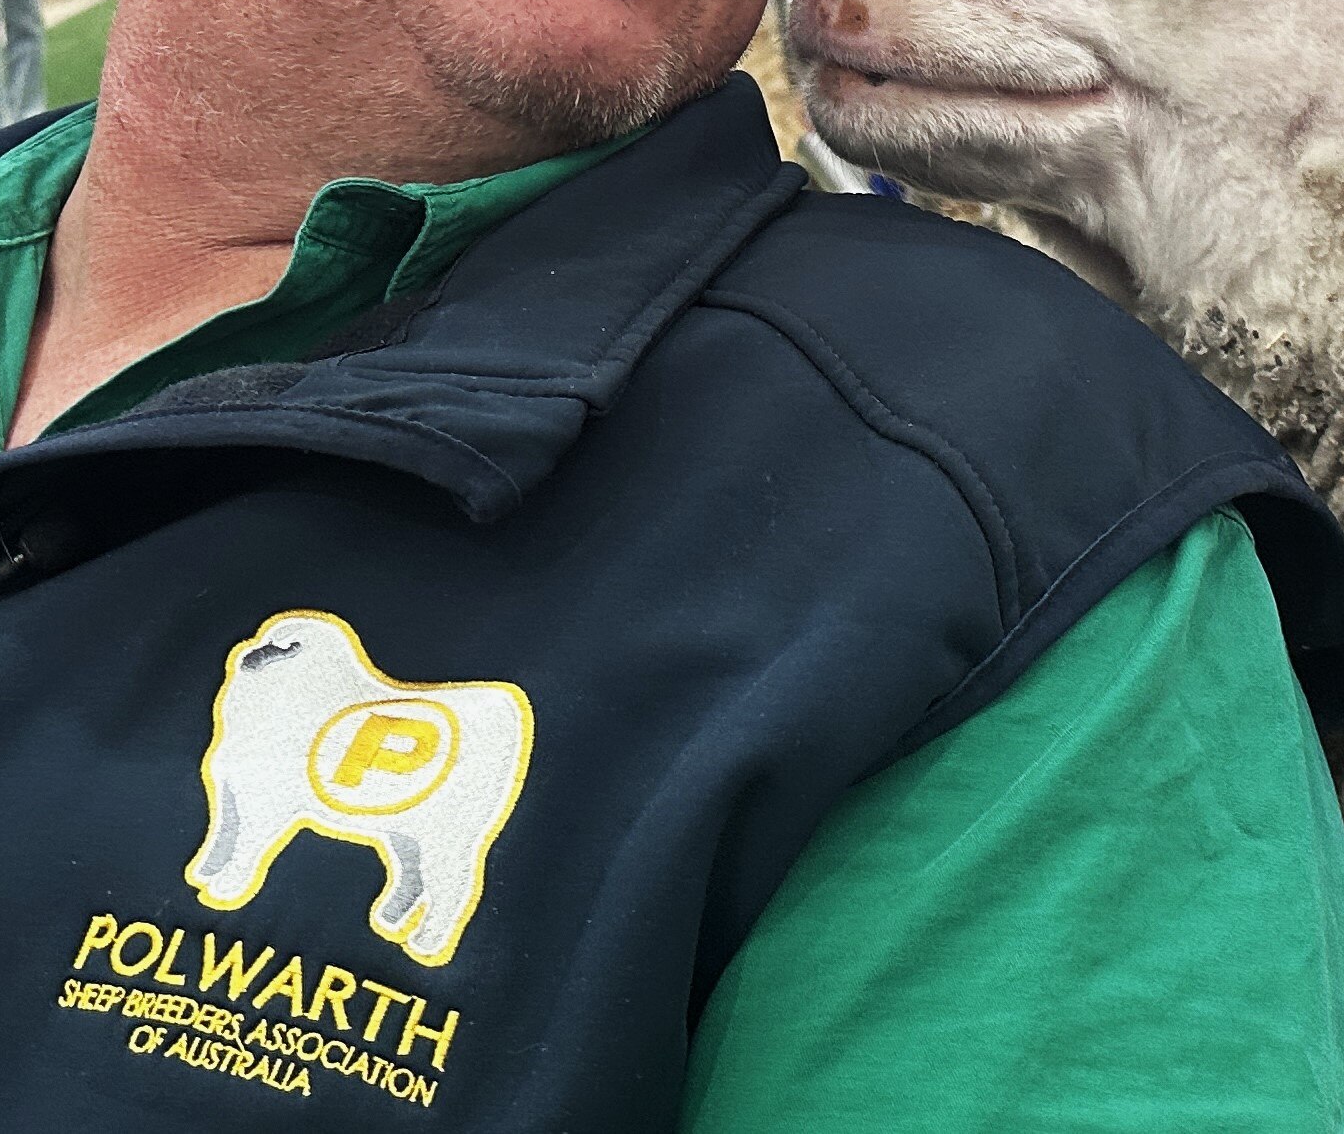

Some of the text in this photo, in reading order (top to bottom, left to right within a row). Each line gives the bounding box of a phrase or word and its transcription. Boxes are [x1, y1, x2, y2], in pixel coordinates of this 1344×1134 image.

[332, 712, 441, 788] P
[58, 978, 126, 1012] SHEEP
[244, 1018, 439, 1108] ASSOCIATION
[73, 913, 461, 1074] POLWARTH
[128, 1024, 313, 1097] OF AUSTRALIA
